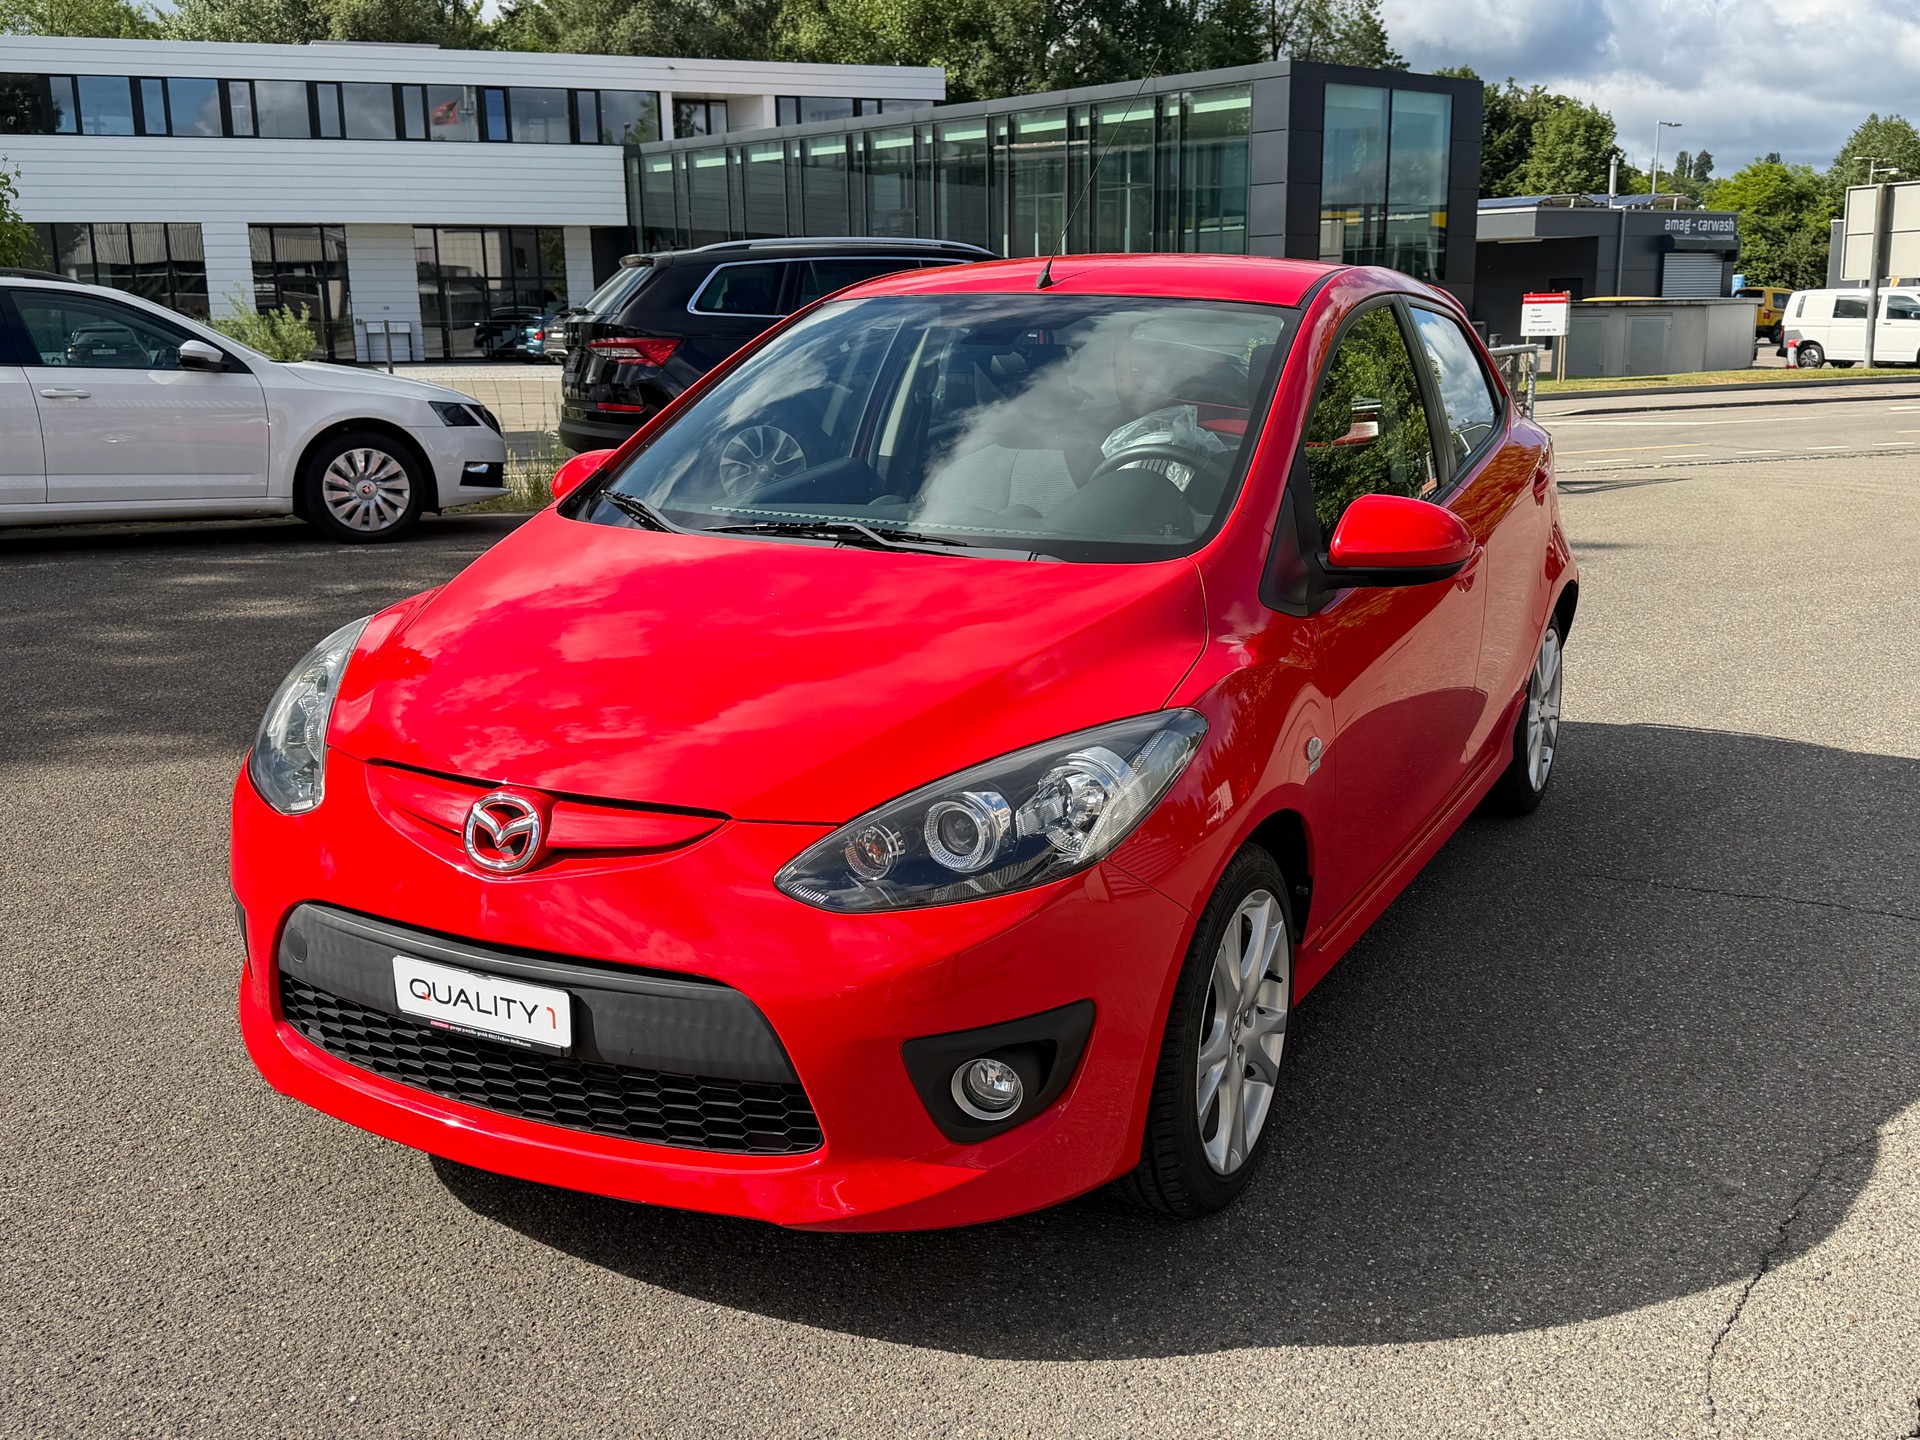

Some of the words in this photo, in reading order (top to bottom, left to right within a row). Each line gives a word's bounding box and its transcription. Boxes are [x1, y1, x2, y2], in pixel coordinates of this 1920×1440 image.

[1664, 217, 1692, 234] amag
[1698, 217, 1735, 232] carwash
[409, 978, 539, 1024] QUALITY
[546, 1006, 557, 1030] 1
